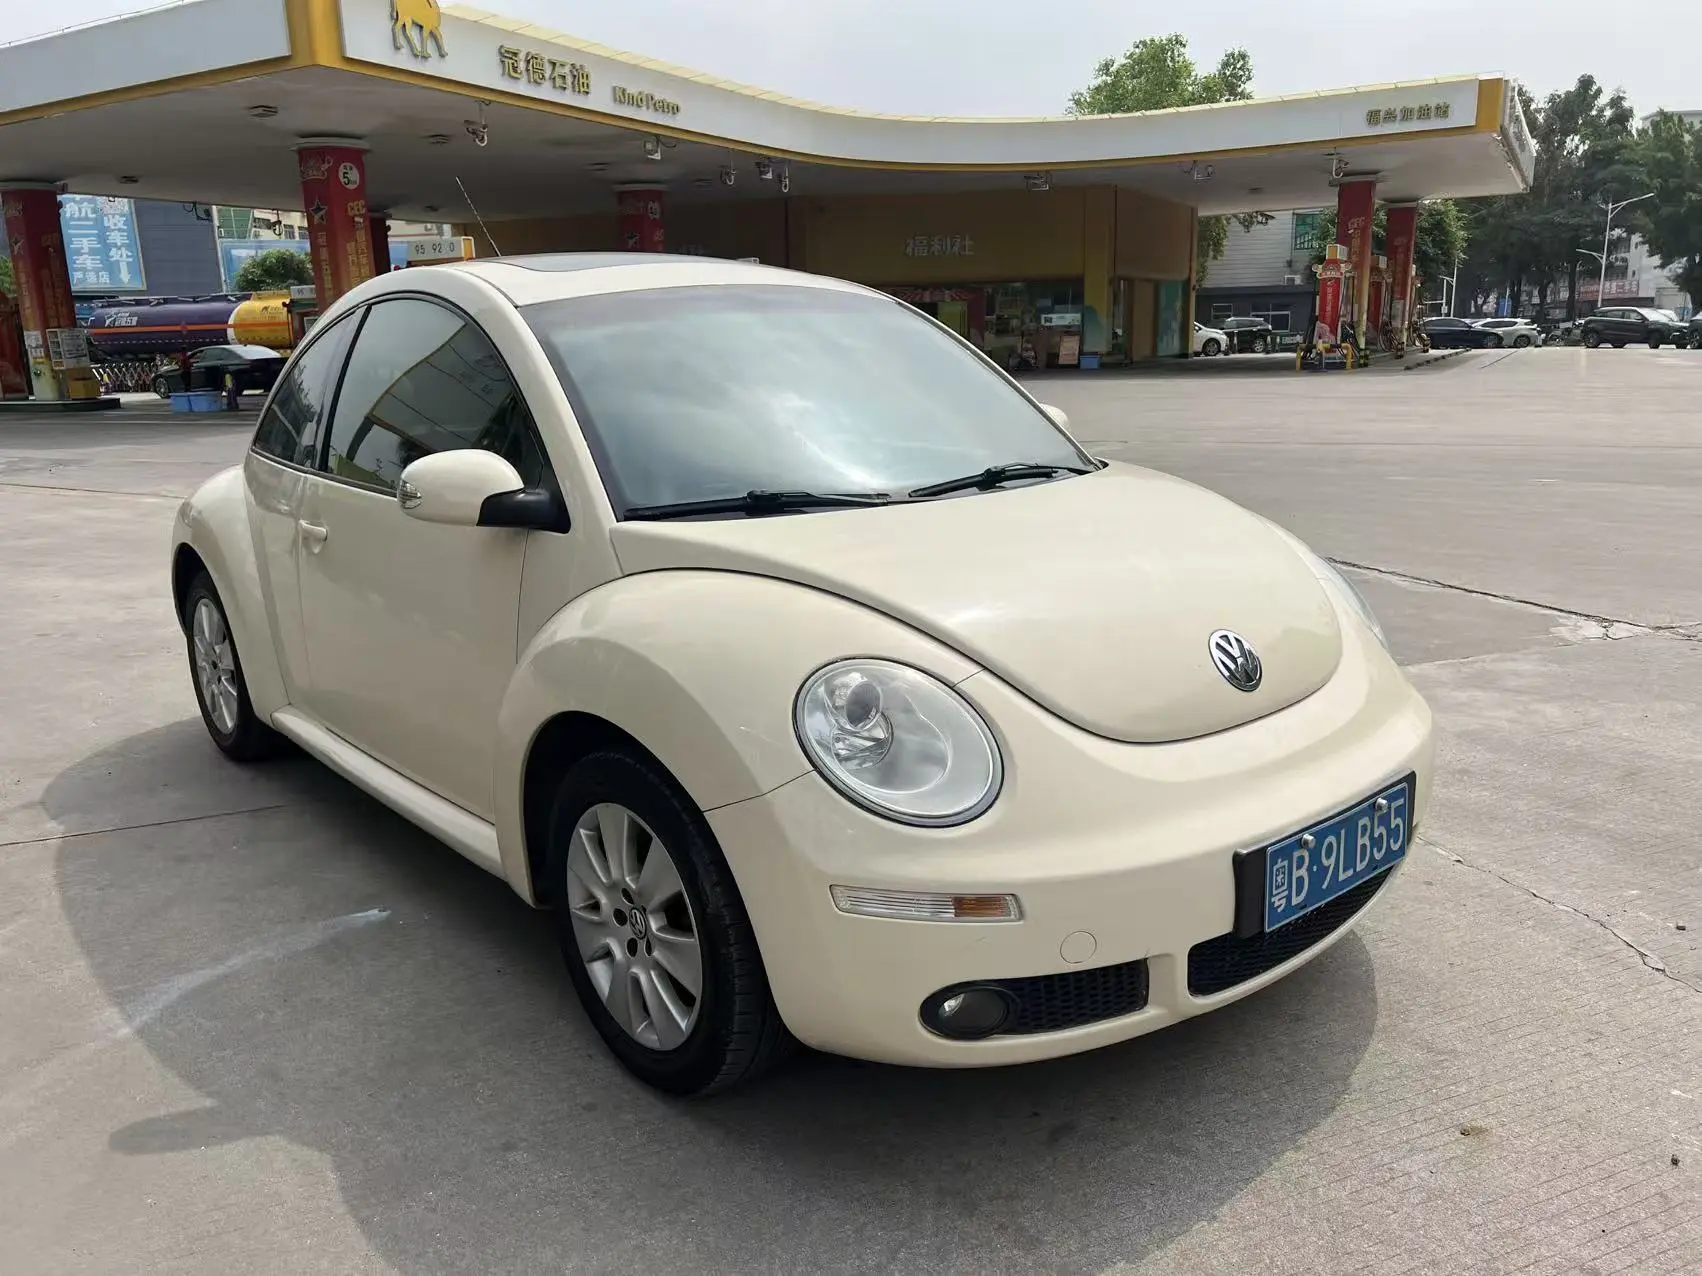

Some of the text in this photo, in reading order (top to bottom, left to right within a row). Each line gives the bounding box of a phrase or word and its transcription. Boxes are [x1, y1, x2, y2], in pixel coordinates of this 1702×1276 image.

[499, 45, 593, 95] 冠德石油
[613, 85, 681, 116] Kind Petro
[103, 214, 133, 262] 收车处
[414, 244, 426, 255] 95
[431, 242, 443, 254] 92
[904, 234, 975, 256] 福利社
